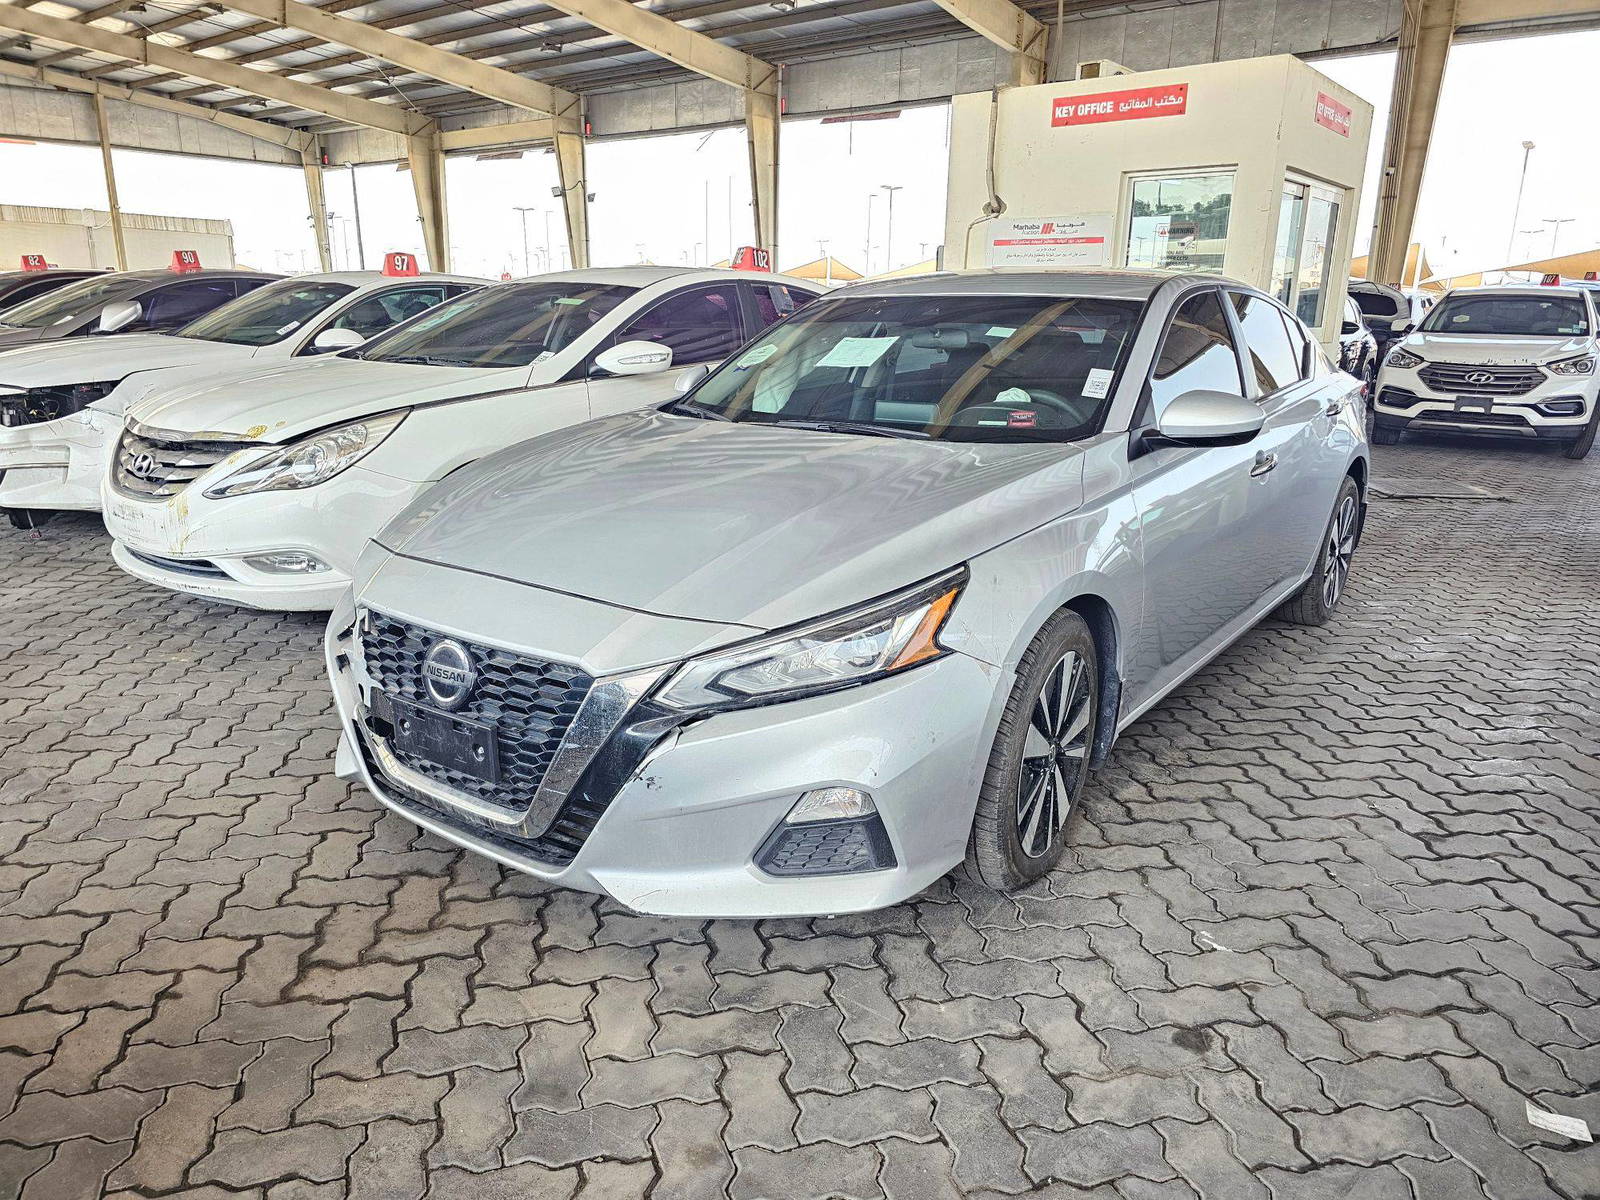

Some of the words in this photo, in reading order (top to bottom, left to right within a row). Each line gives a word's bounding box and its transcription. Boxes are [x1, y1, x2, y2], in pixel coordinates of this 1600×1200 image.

[1119, 97, 1152, 112] المفاتيح
[1155, 95, 1183, 108] مكتب
[1055, 105, 1074, 118] KEY
[1077, 101, 1114, 116] OFFICE
[1013, 223, 1040, 231] Marhaba
[28, 255, 41, 266] 82
[182, 251, 194, 264] 90
[394, 255, 408, 271] 97
[754, 249, 769, 268] 102
[427, 664, 466, 683] NISSAN
